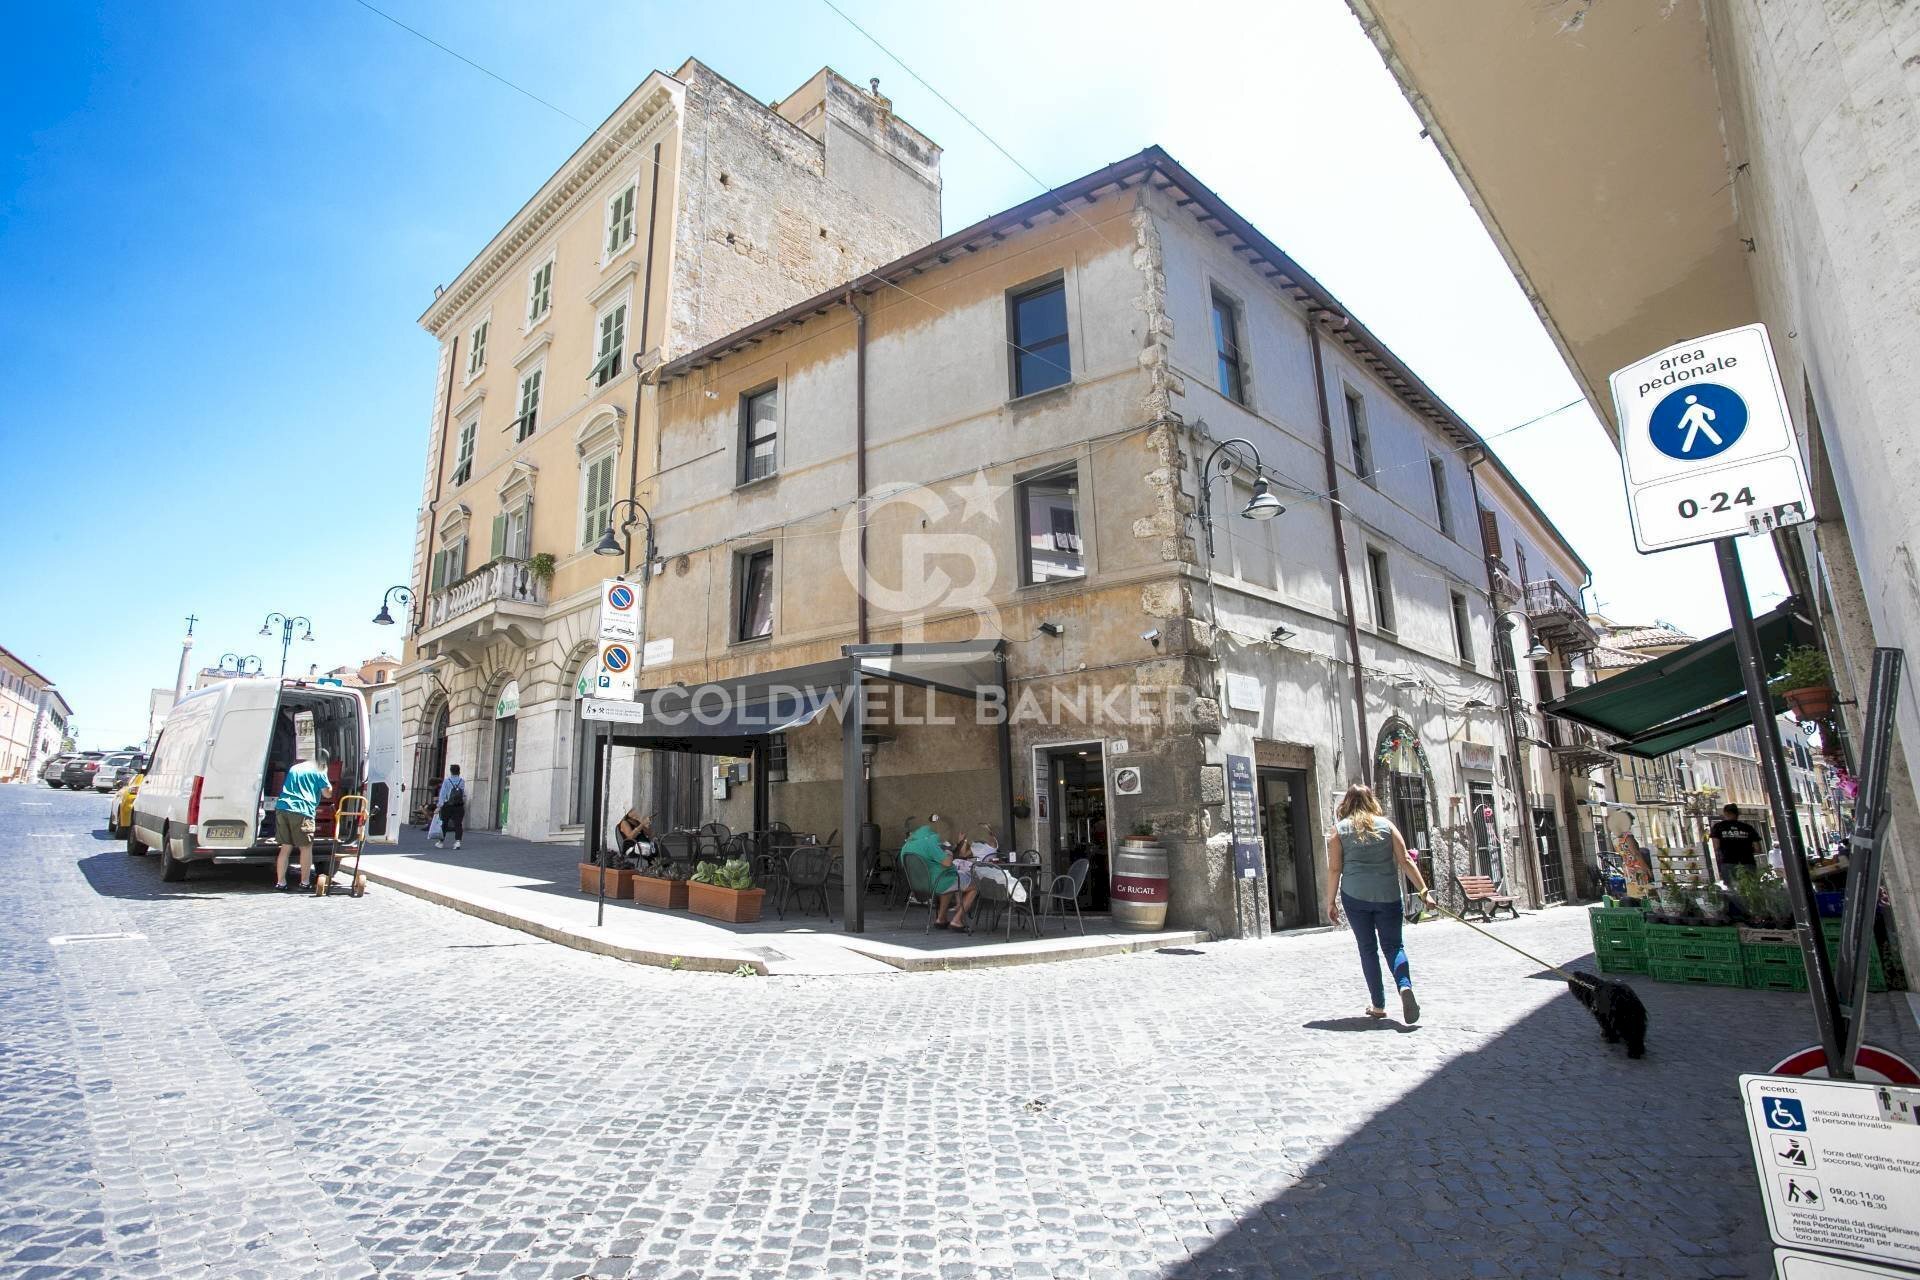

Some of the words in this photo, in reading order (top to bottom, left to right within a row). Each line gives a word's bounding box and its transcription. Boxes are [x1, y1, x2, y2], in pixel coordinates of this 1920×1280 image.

[1660, 349, 1705, 371] area
[1639, 357, 1738, 398] pedonale
[1678, 486, 1756, 519] 0-24
[1127, 885, 1156, 895] RUGATE
[1760, 1085, 1798, 1094] eccetto:
[1822, 1117, 1857, 1127] persone
